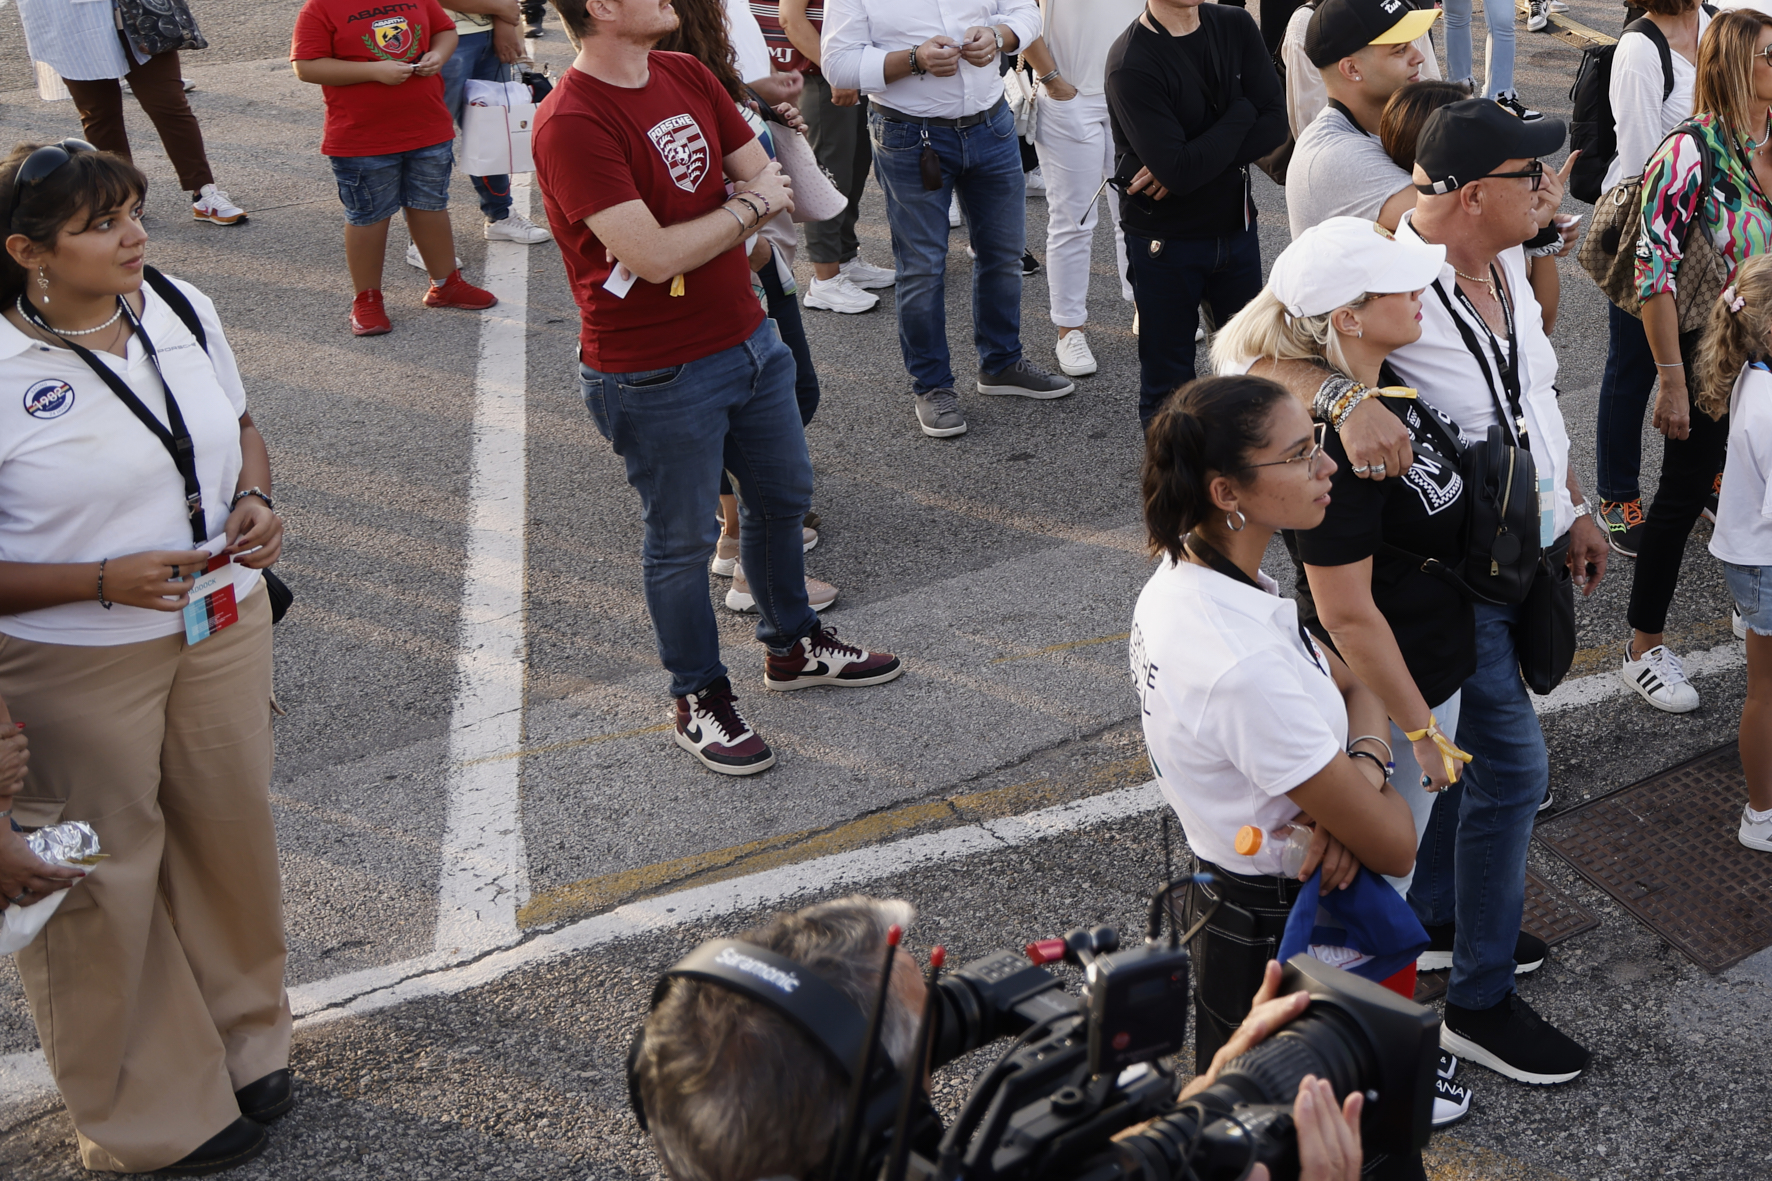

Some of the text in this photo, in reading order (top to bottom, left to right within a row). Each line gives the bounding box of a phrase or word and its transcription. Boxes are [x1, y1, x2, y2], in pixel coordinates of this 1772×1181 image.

[346, 2, 418, 24] ABARTH
[372, 17, 407, 28] ABARTH
[768, 46, 795, 63] MJ
[650, 116, 694, 140] PORSCHE
[1460, 295, 1492, 336] PORSCHE
[157, 342, 196, 354] PORSCHE
[33, 387, 64, 410] 1982
[714, 946, 800, 992] Saramonic
